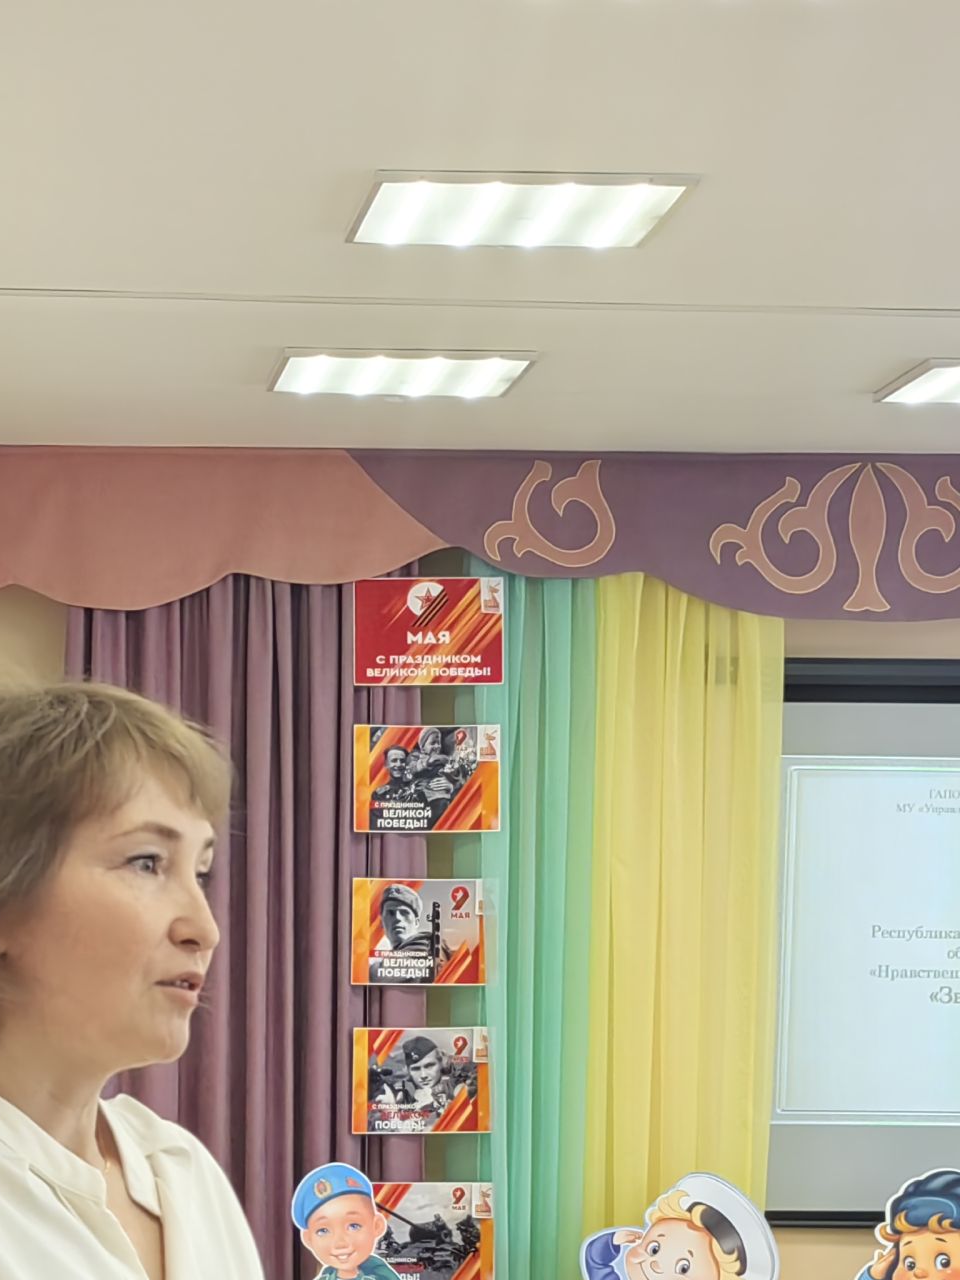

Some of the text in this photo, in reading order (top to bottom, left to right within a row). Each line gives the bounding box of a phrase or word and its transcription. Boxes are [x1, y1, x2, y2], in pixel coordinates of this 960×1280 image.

[406, 630, 451, 645] МАЯ
[376, 653, 481, 665] С ПРАЗДНИКОМ
[366, 664, 491, 678] ВЕЛИКОЙ ПОБЕДЫ!
[382, 807, 432, 818] ВЕЛИКОЙ
[377, 818, 428, 829] ПОБЕДЫ!
[450, 886, 470, 910] 9
[450, 911, 470, 919] МАЯ
[383, 956, 434, 967] ВЕЛИКОЙ
[377, 968, 429, 979] ПОБЕДЫ!
[453, 1036, 468, 1055] 9
[452, 1187, 466, 1204] 9
